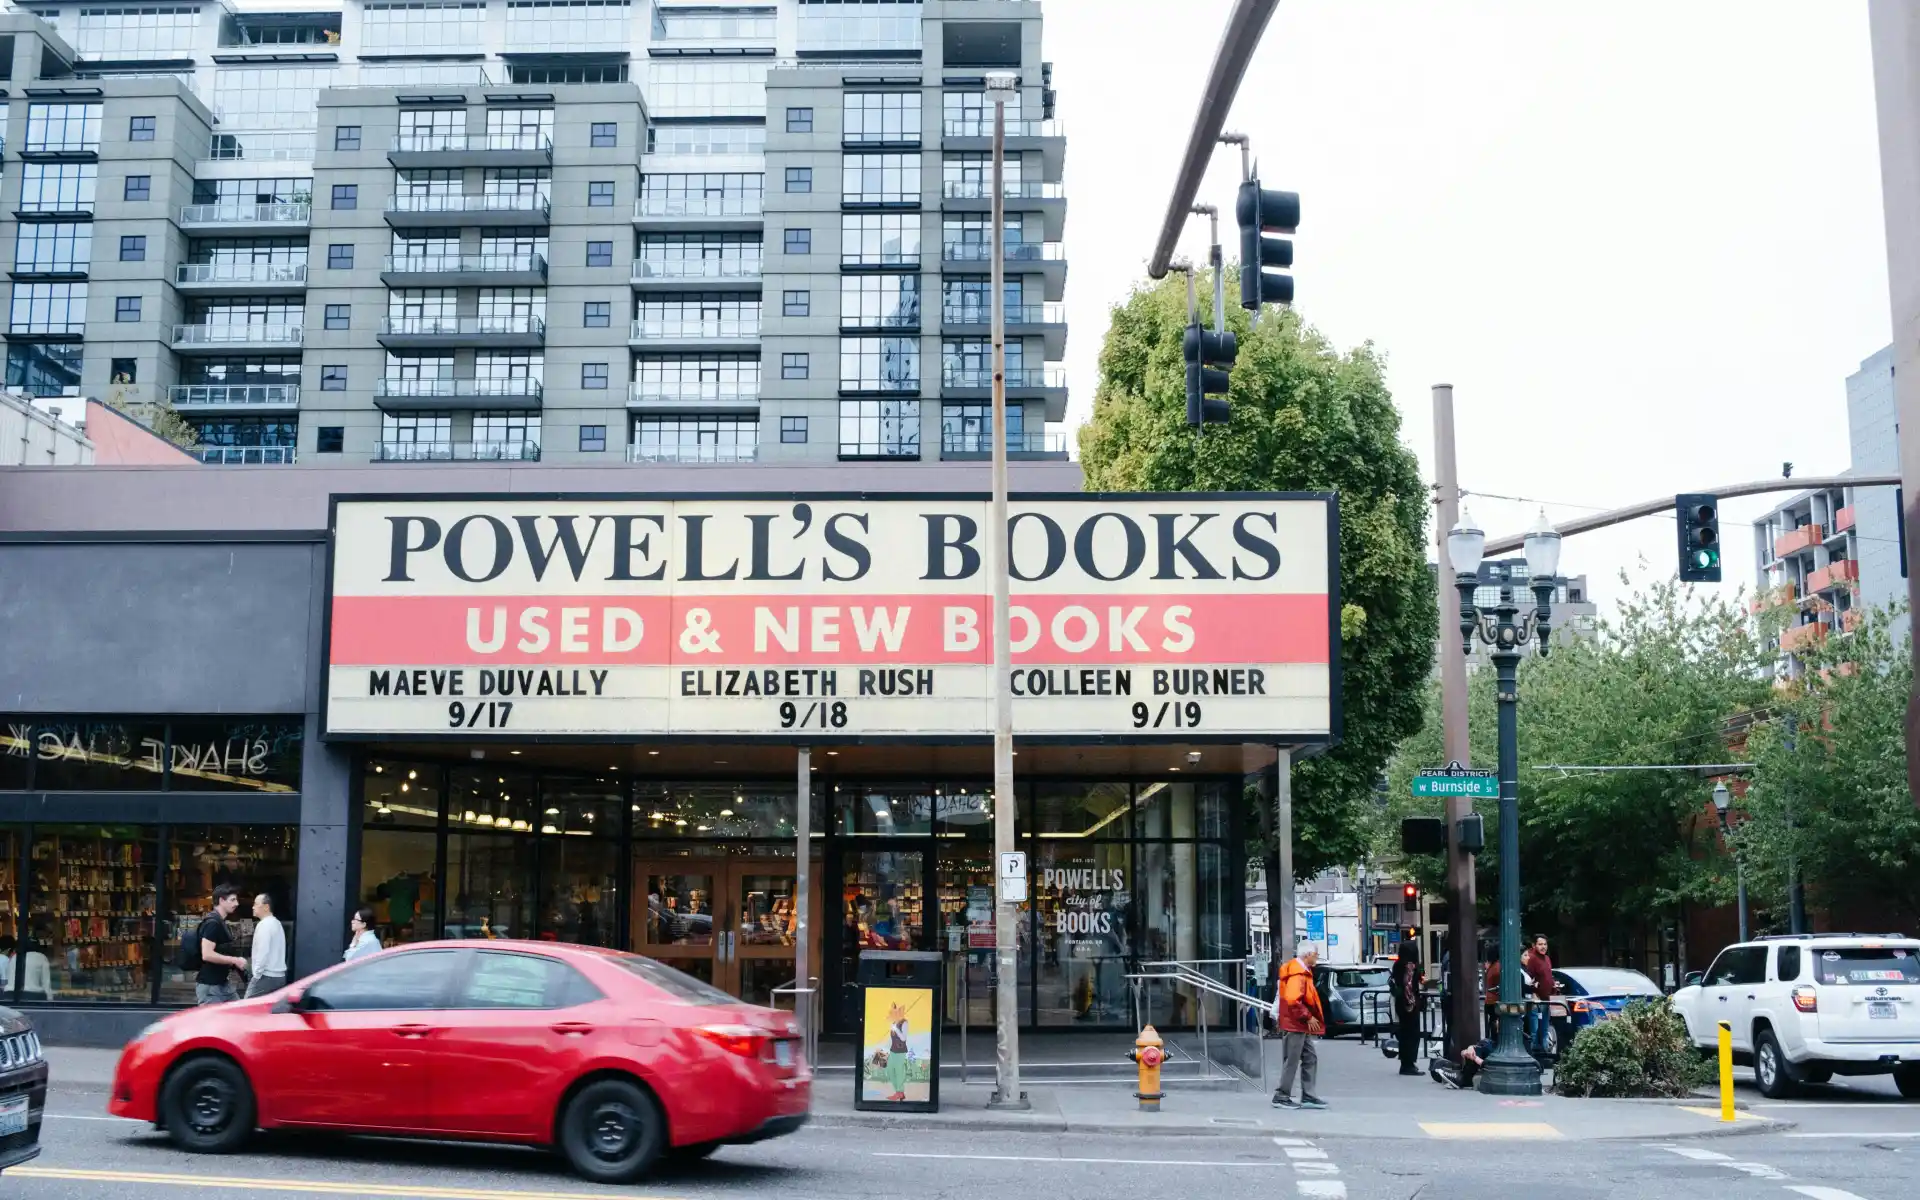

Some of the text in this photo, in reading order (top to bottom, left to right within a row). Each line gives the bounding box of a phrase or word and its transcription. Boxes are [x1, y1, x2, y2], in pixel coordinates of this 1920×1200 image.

[382, 503, 1281, 582] POWELL'S BOOKS
[467, 605, 1195, 653] USED & NEW BOOKS
[370, 670, 608, 695] MAEVE DUVALLY
[681, 669, 933, 696] ELIZABETH RUSH
[1011, 669, 1265, 695] COLLEEN BURNER
[448, 701, 513, 727] 9/17
[779, 701, 847, 728] 9/18
[1131, 702, 1201, 728] 9/19
[1431, 781, 1481, 793] Burnside
[1066, 895, 1103, 909] city of
[1057, 912, 1111, 933] BOOKS
